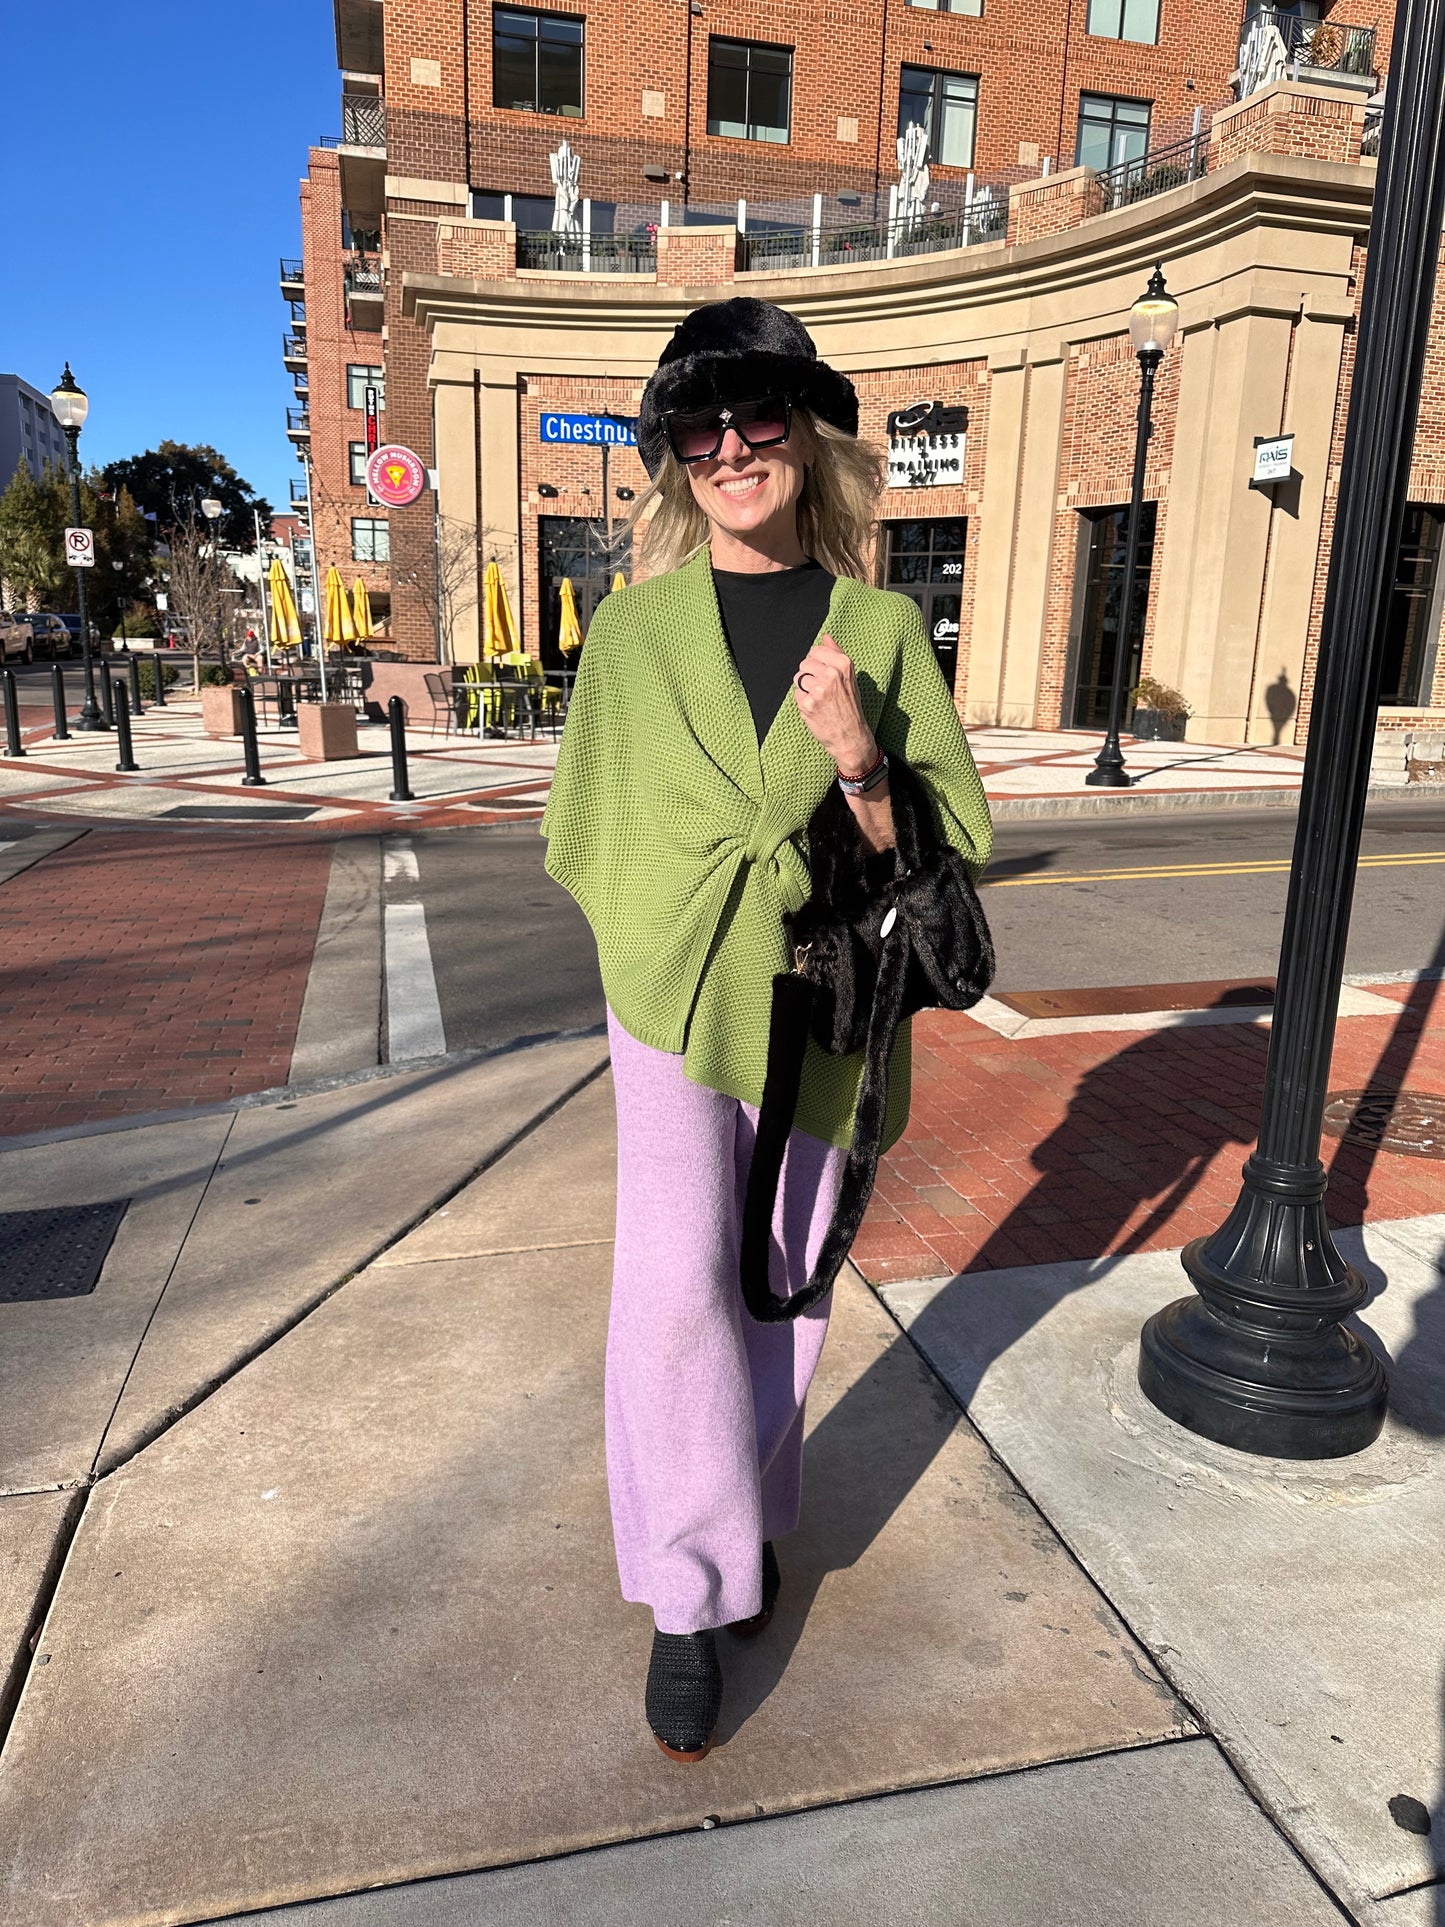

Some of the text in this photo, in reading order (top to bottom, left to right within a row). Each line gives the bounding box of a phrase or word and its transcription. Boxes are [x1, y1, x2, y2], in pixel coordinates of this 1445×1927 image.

[891, 434, 960, 451] FITNESS
[372, 451, 420, 487] MELLOW MUSHROOM
[889, 458, 960, 474] TRAINING
[942, 563, 962, 574] 202
